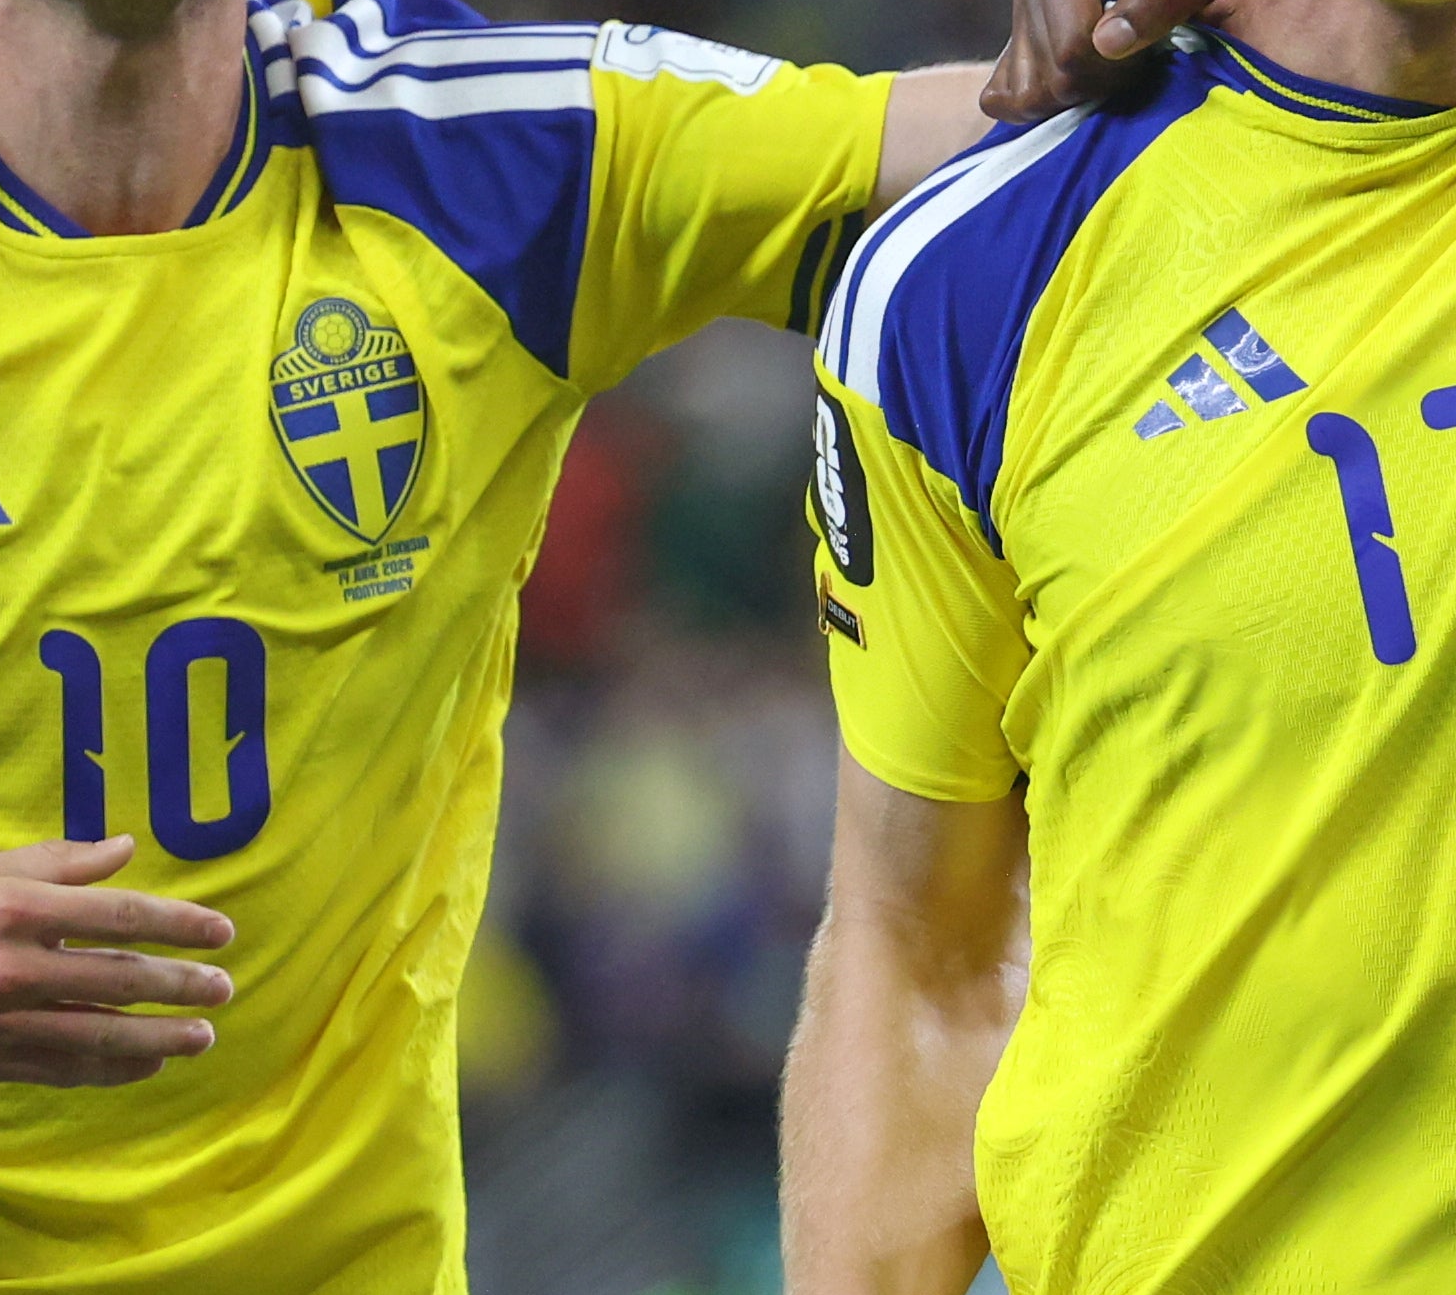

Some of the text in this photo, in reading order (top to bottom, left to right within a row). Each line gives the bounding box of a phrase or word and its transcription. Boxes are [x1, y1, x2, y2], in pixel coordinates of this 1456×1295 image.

[289, 360, 398, 400] SVERIGE
[827, 599, 857, 629] DEBUT
[39, 617, 271, 861] 10
